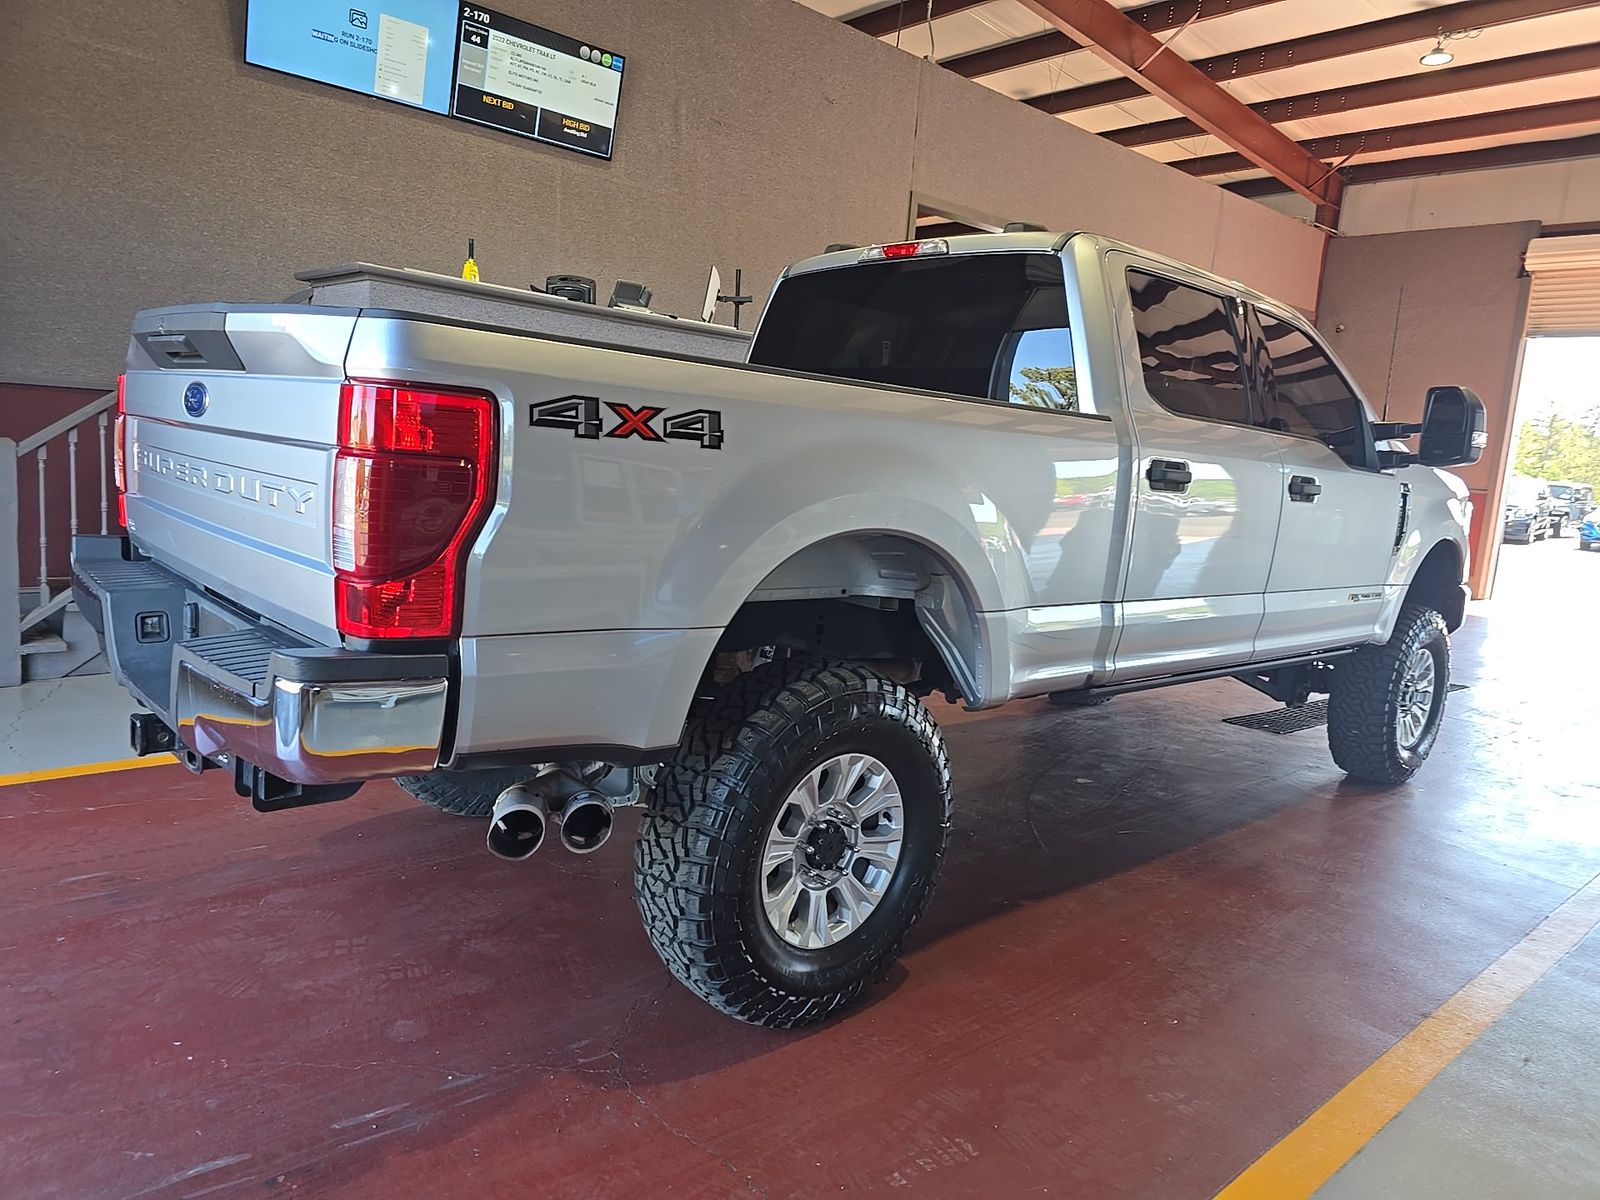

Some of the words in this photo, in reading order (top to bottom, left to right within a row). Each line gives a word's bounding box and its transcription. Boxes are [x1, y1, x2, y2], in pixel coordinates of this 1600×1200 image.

[463, 7, 490, 24] 2-170
[339, 38, 349, 46] ON
[341, 31, 355, 40] RUN
[355, 34, 373, 45] 2-170
[470, 34, 481, 44] 44
[506, 38, 536, 53] CHEVROLET
[482, 94, 502, 107] NEXT
[501, 100, 515, 110] BID
[562, 118, 579, 130] HIGH
[579, 123, 591, 132] BID
[214, 472, 313, 514] DUTY
